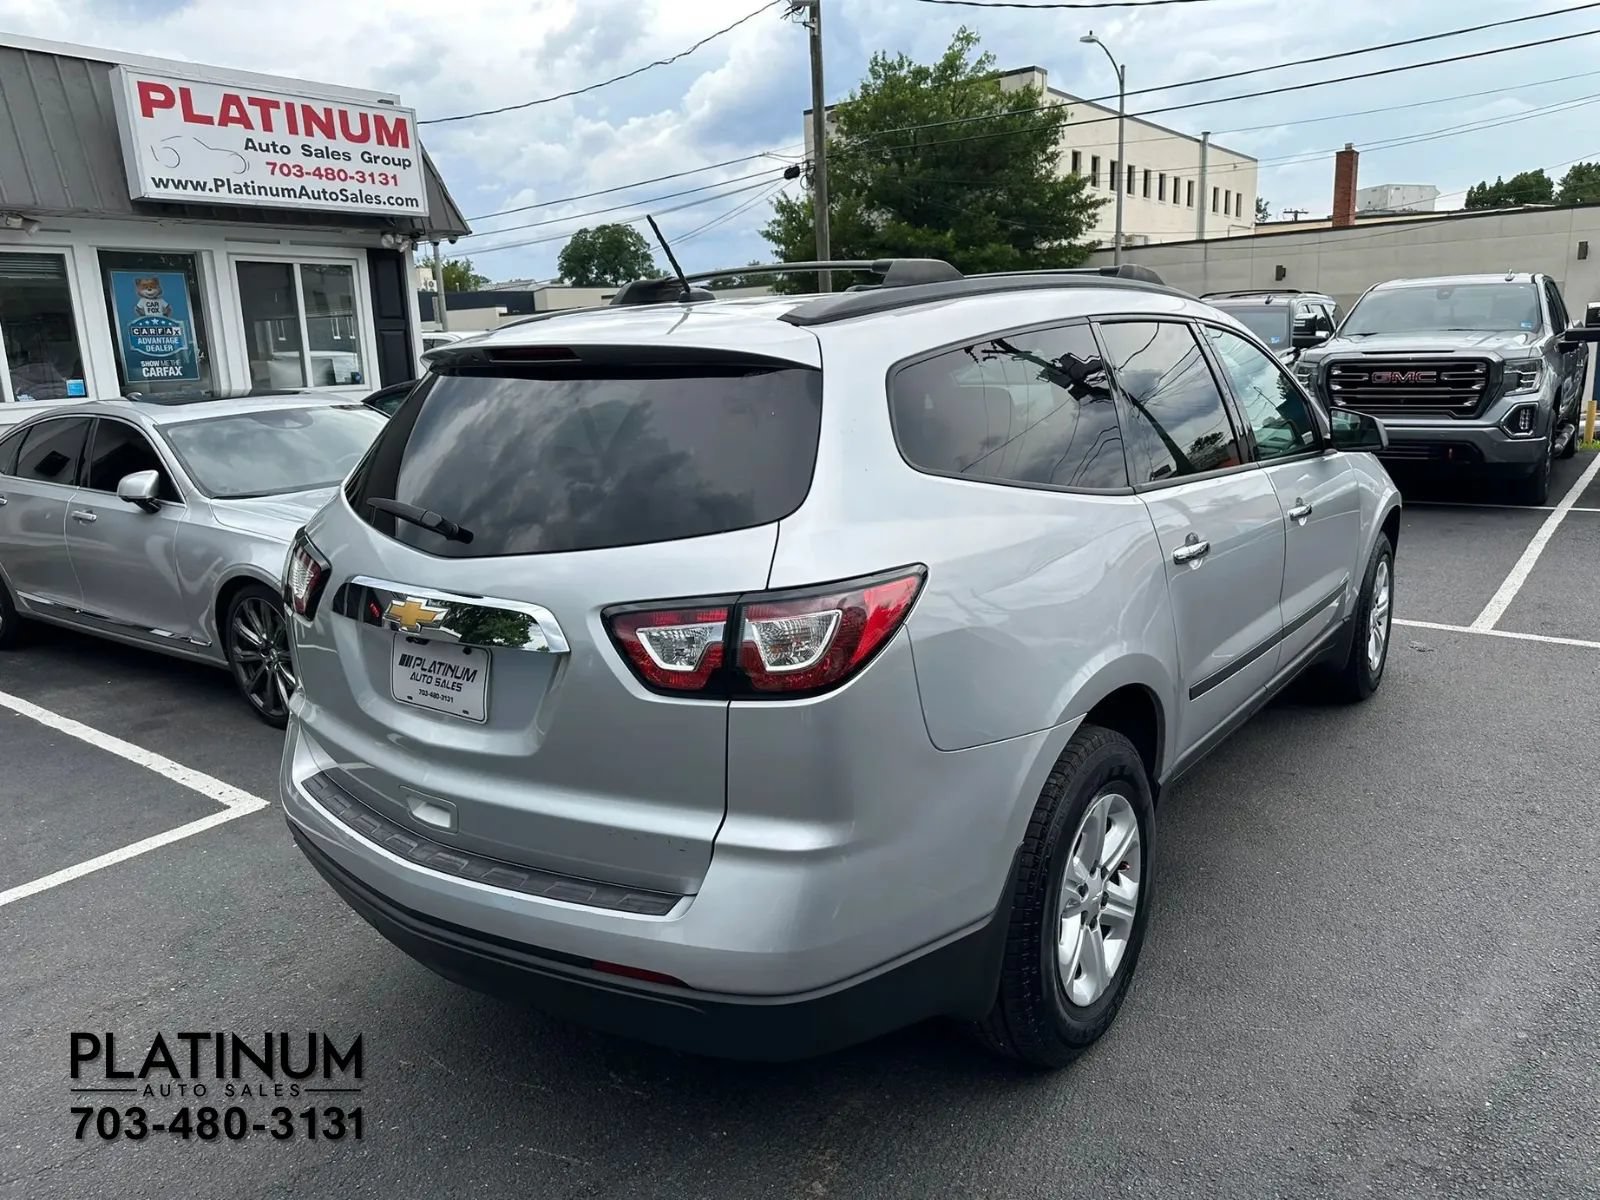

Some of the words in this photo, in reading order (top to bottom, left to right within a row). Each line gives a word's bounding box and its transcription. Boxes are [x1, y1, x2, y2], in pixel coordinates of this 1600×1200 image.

[136, 80, 410, 149] PLATINUM
[244, 137, 291, 155] Auto
[301, 143, 351, 162] Sales
[360, 151, 412, 169] Group
[266, 161, 399, 187] 703-480-3131
[150, 175, 419, 208] www.PlatinumAutoSales.com
[132, 327, 181, 336] CARFAX
[137, 337, 180, 345] ADVANTAGE
[145, 344, 174, 352] DEALER
[142, 366, 183, 378] CARFAX
[1371, 371, 1437, 384] GMC
[412, 656, 478, 683] PLATINUM
[410, 671, 433, 685] AUTO
[434, 677, 463, 692] SALES
[418, 688, 454, 703] 703-480-3131
